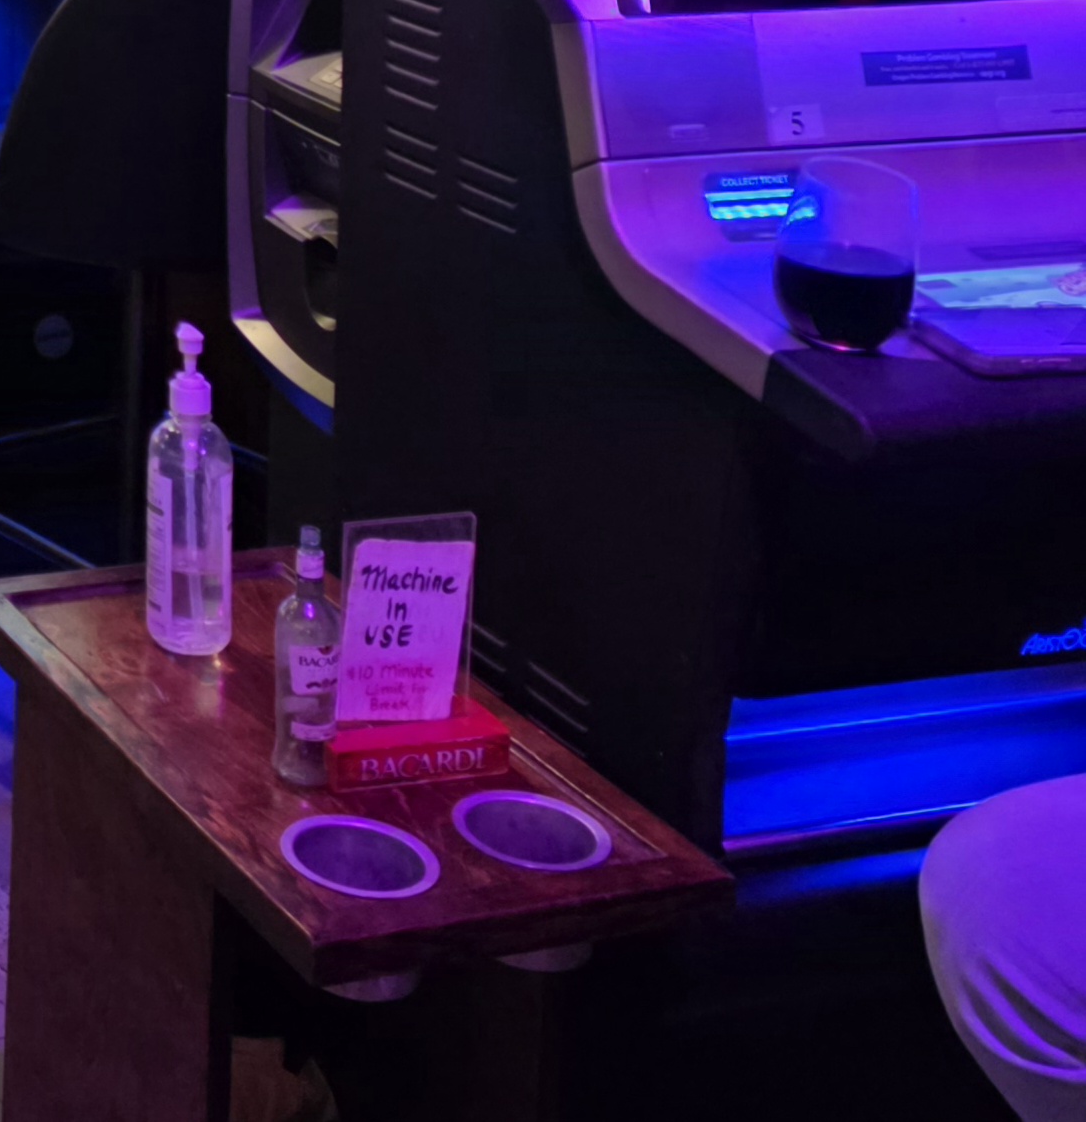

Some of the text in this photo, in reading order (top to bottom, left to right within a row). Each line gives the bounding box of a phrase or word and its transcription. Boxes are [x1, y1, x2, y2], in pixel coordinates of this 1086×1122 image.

[790, 110, 806, 137] 5
[721, 176, 757, 188] COLLECT
[361, 564, 459, 595] Machine
[387, 597, 408, 622] In
[365, 624, 414, 649] USE
[380, 663, 435, 680] Minute
[370, 698, 410, 711] Break
[360, 745, 488, 783] BACARDI
